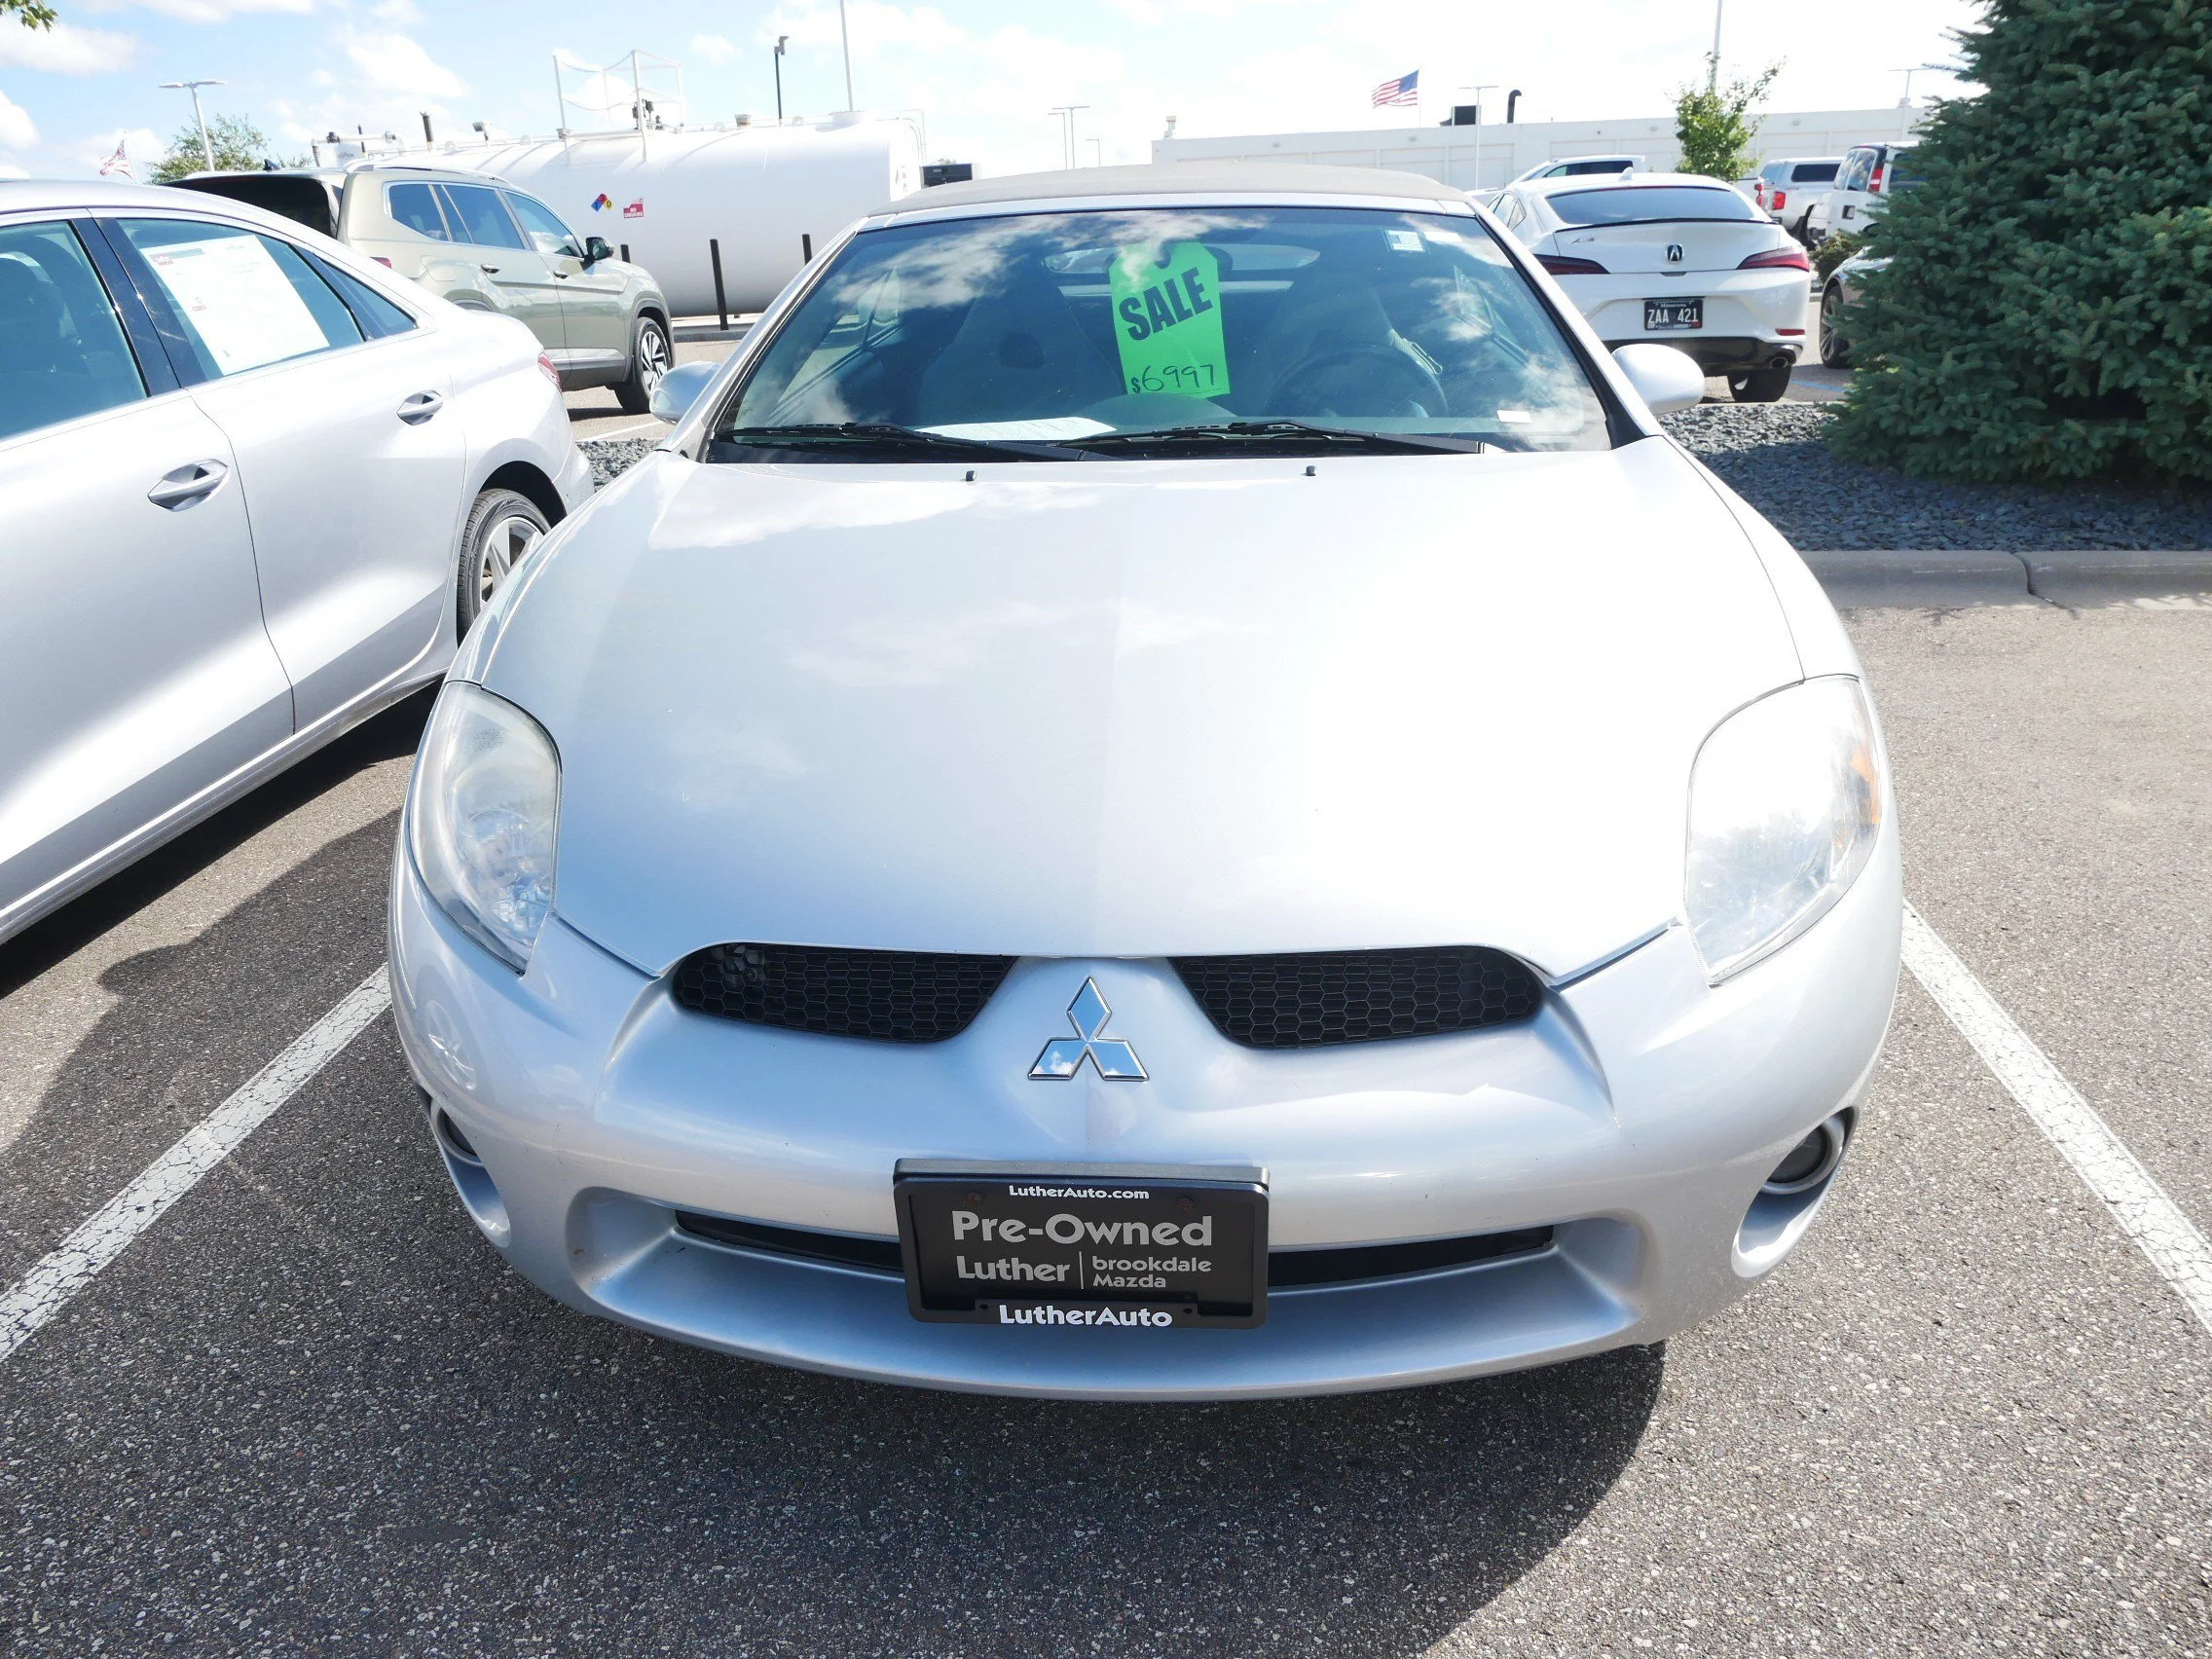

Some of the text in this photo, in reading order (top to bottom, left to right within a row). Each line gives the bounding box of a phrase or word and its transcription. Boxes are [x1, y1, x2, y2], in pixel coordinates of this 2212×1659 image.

[1119, 267, 1214, 341] SALE
[1647, 308, 1699, 323] ZAA 421
[1130, 364, 1215, 393] $6997
[1009, 1185, 1150, 1199] LutherAuto.com
[952, 1210, 1212, 1246] Pre-Owned
[956, 1255, 1071, 1282] Luther
[1091, 1255, 1212, 1272] brookdale
[1092, 1273, 1166, 1288] Mazda
[999, 1305, 1173, 1327] LutherAuto
